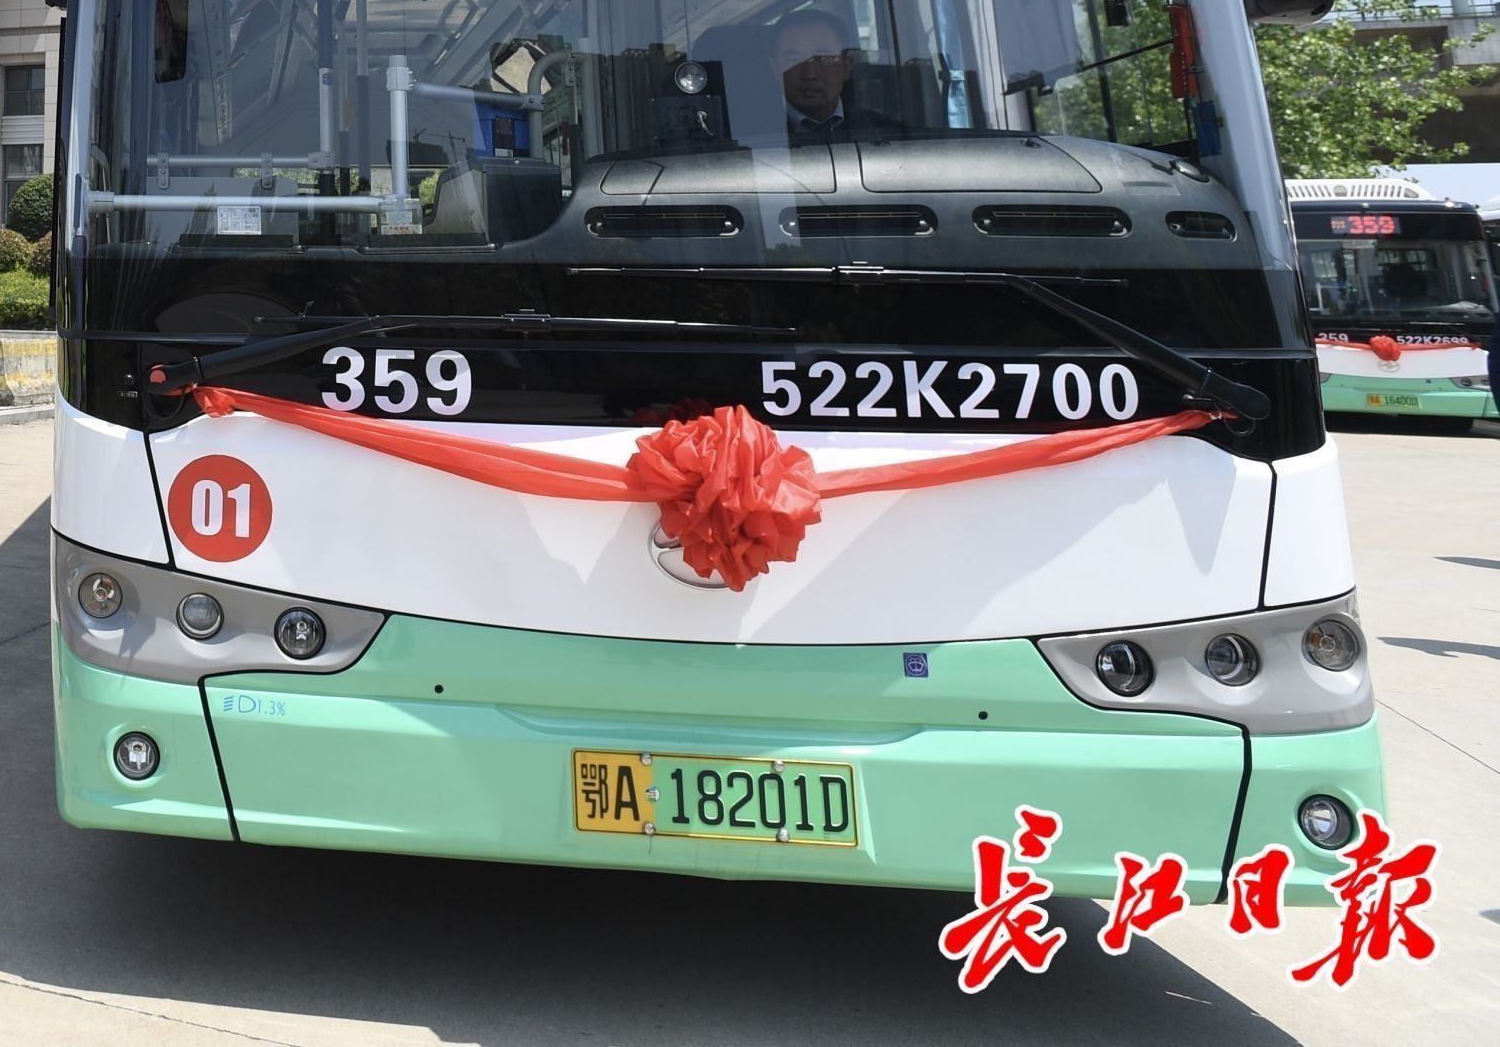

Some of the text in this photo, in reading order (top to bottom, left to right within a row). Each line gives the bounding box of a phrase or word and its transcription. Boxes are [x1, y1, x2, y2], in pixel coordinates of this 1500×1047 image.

[1347, 215, 1395, 234] 359
[320, 346, 473, 416] 359
[760, 359, 1140, 422] 522K2700
[191, 479, 252, 539] 01
[580, 763, 850, 832] 鄂A 18201D
